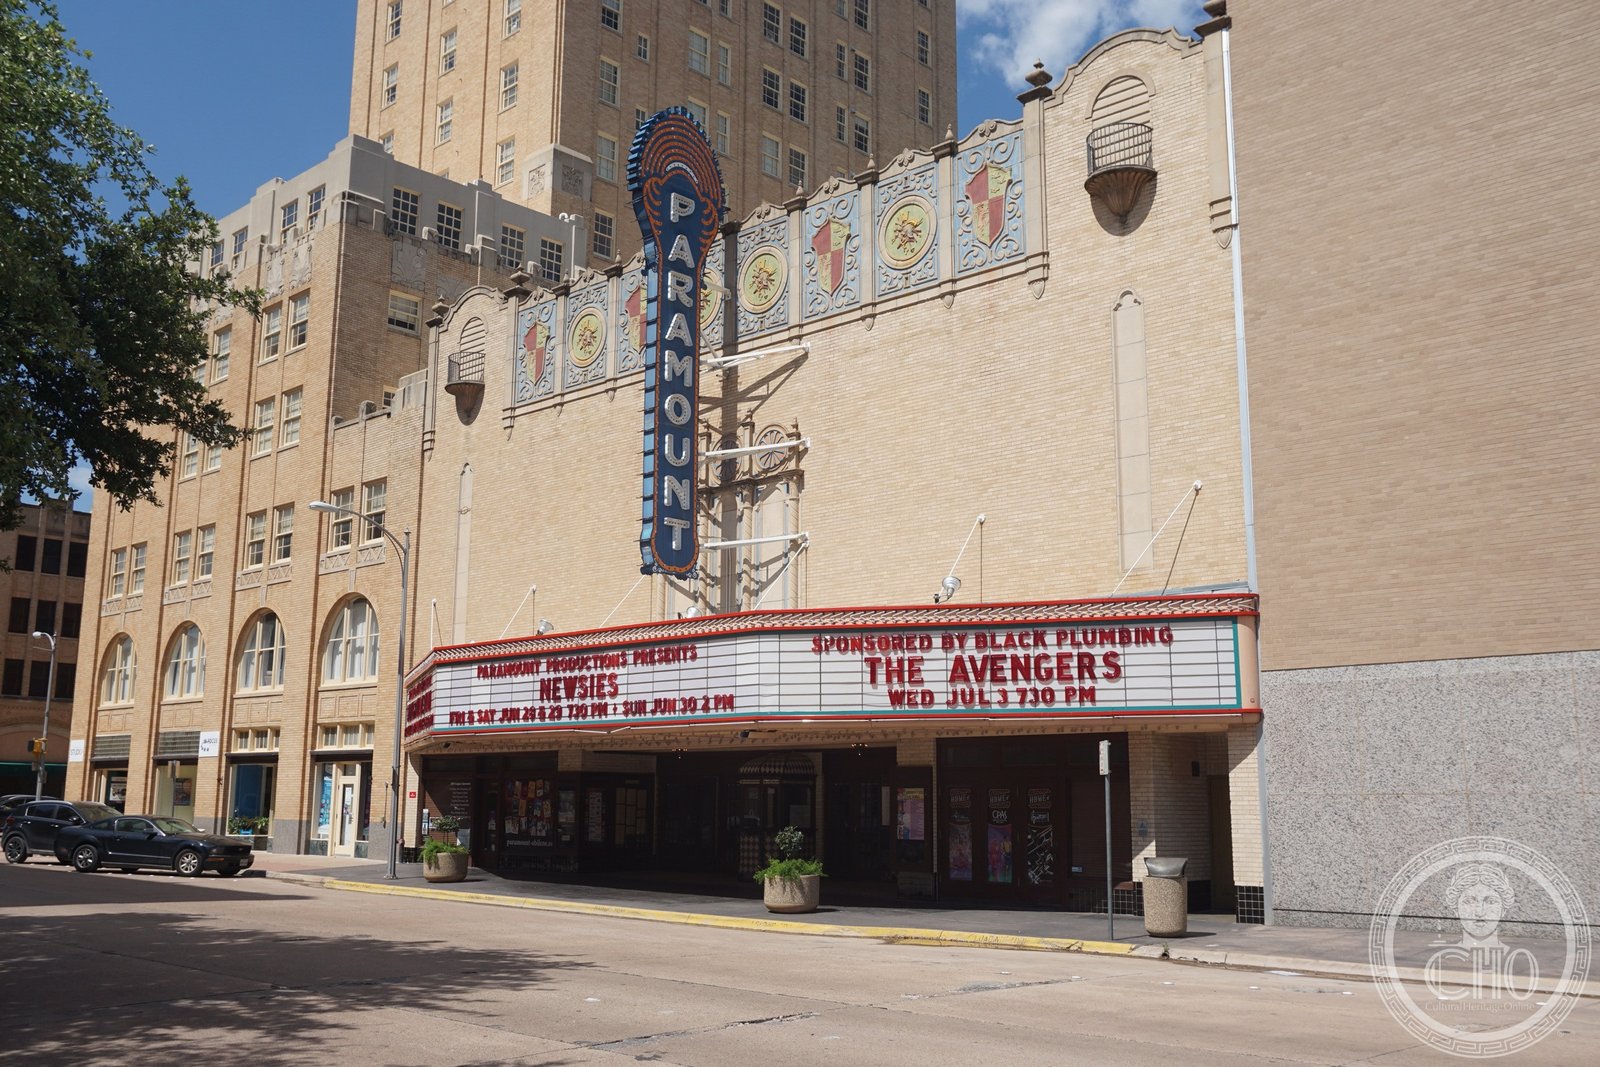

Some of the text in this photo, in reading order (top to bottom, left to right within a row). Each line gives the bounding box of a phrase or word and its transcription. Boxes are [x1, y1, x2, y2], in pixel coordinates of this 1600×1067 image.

[663, 191, 696, 552] PARAMOUNT
[810, 625, 1174, 654] SPONSORED BY BLACK PLUMBING
[477, 644, 698, 679] PARAMOUNT PRODUCTIONS PRESENTS
[864, 650, 1123, 688] THE AVENGERS
[539, 672, 619, 703] NEWSIES
[887, 687, 936, 708] WED
[945, 687, 992, 708] JUL
[996, 687, 1009, 707] 3
[1064, 685, 1097, 705] PM
[449, 711, 466, 726] FRI
[477, 709, 497, 724] SAT
[499, 707, 521, 723] JUN
[590, 701, 608, 719] PM
[622, 699, 647, 717] SUN
[650, 697, 676, 716] JUN
[680, 696, 698, 714] 30
[701, 695, 710, 713] 2
[713, 694, 735, 712] PM
